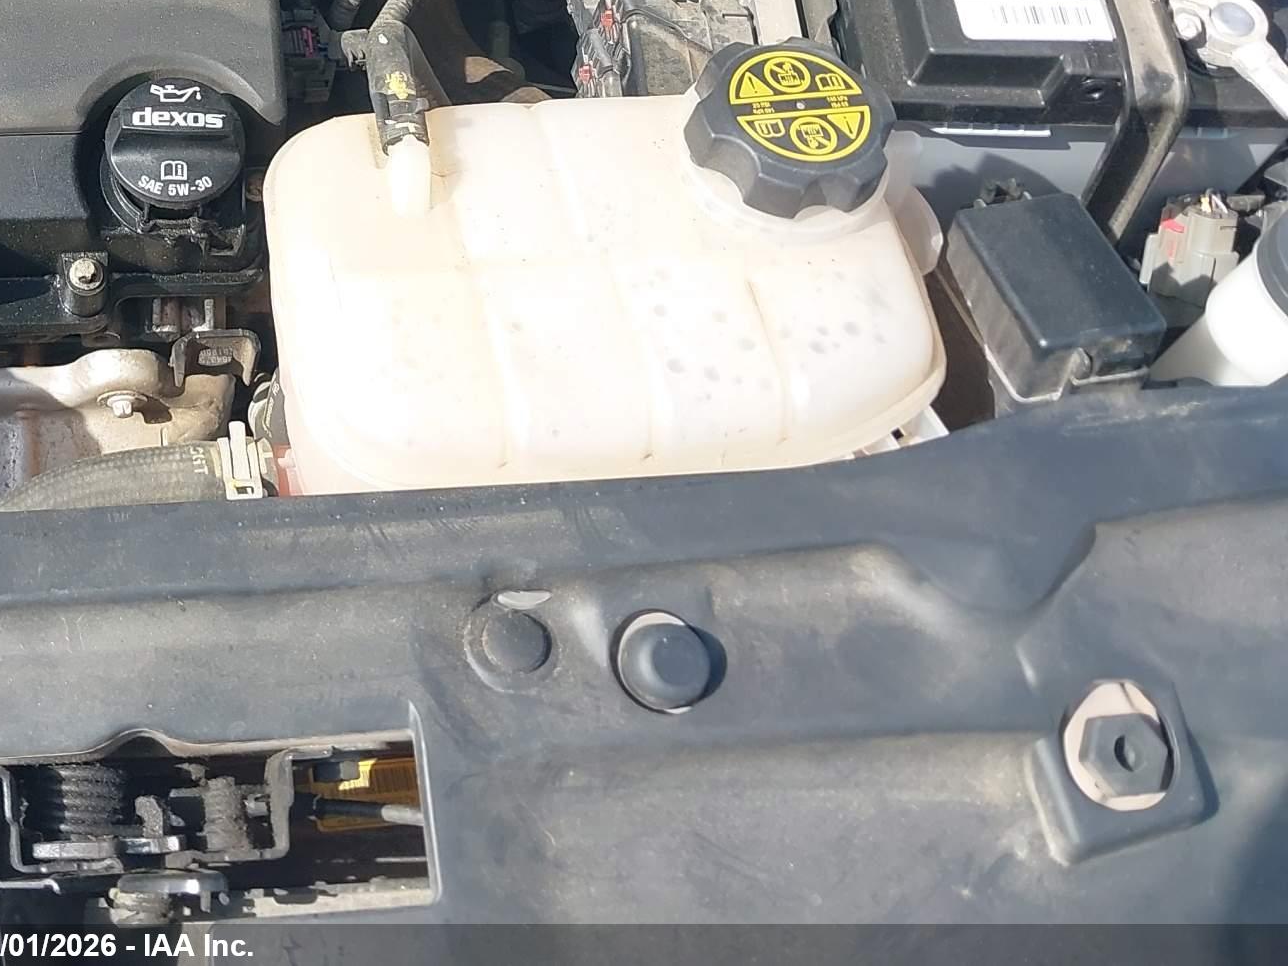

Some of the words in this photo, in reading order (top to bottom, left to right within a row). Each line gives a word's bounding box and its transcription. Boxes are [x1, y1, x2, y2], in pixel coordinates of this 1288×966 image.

[132, 107, 225, 128] dexos
[138, 175, 163, 194] SAE
[168, 176, 212, 196] 5W-30
